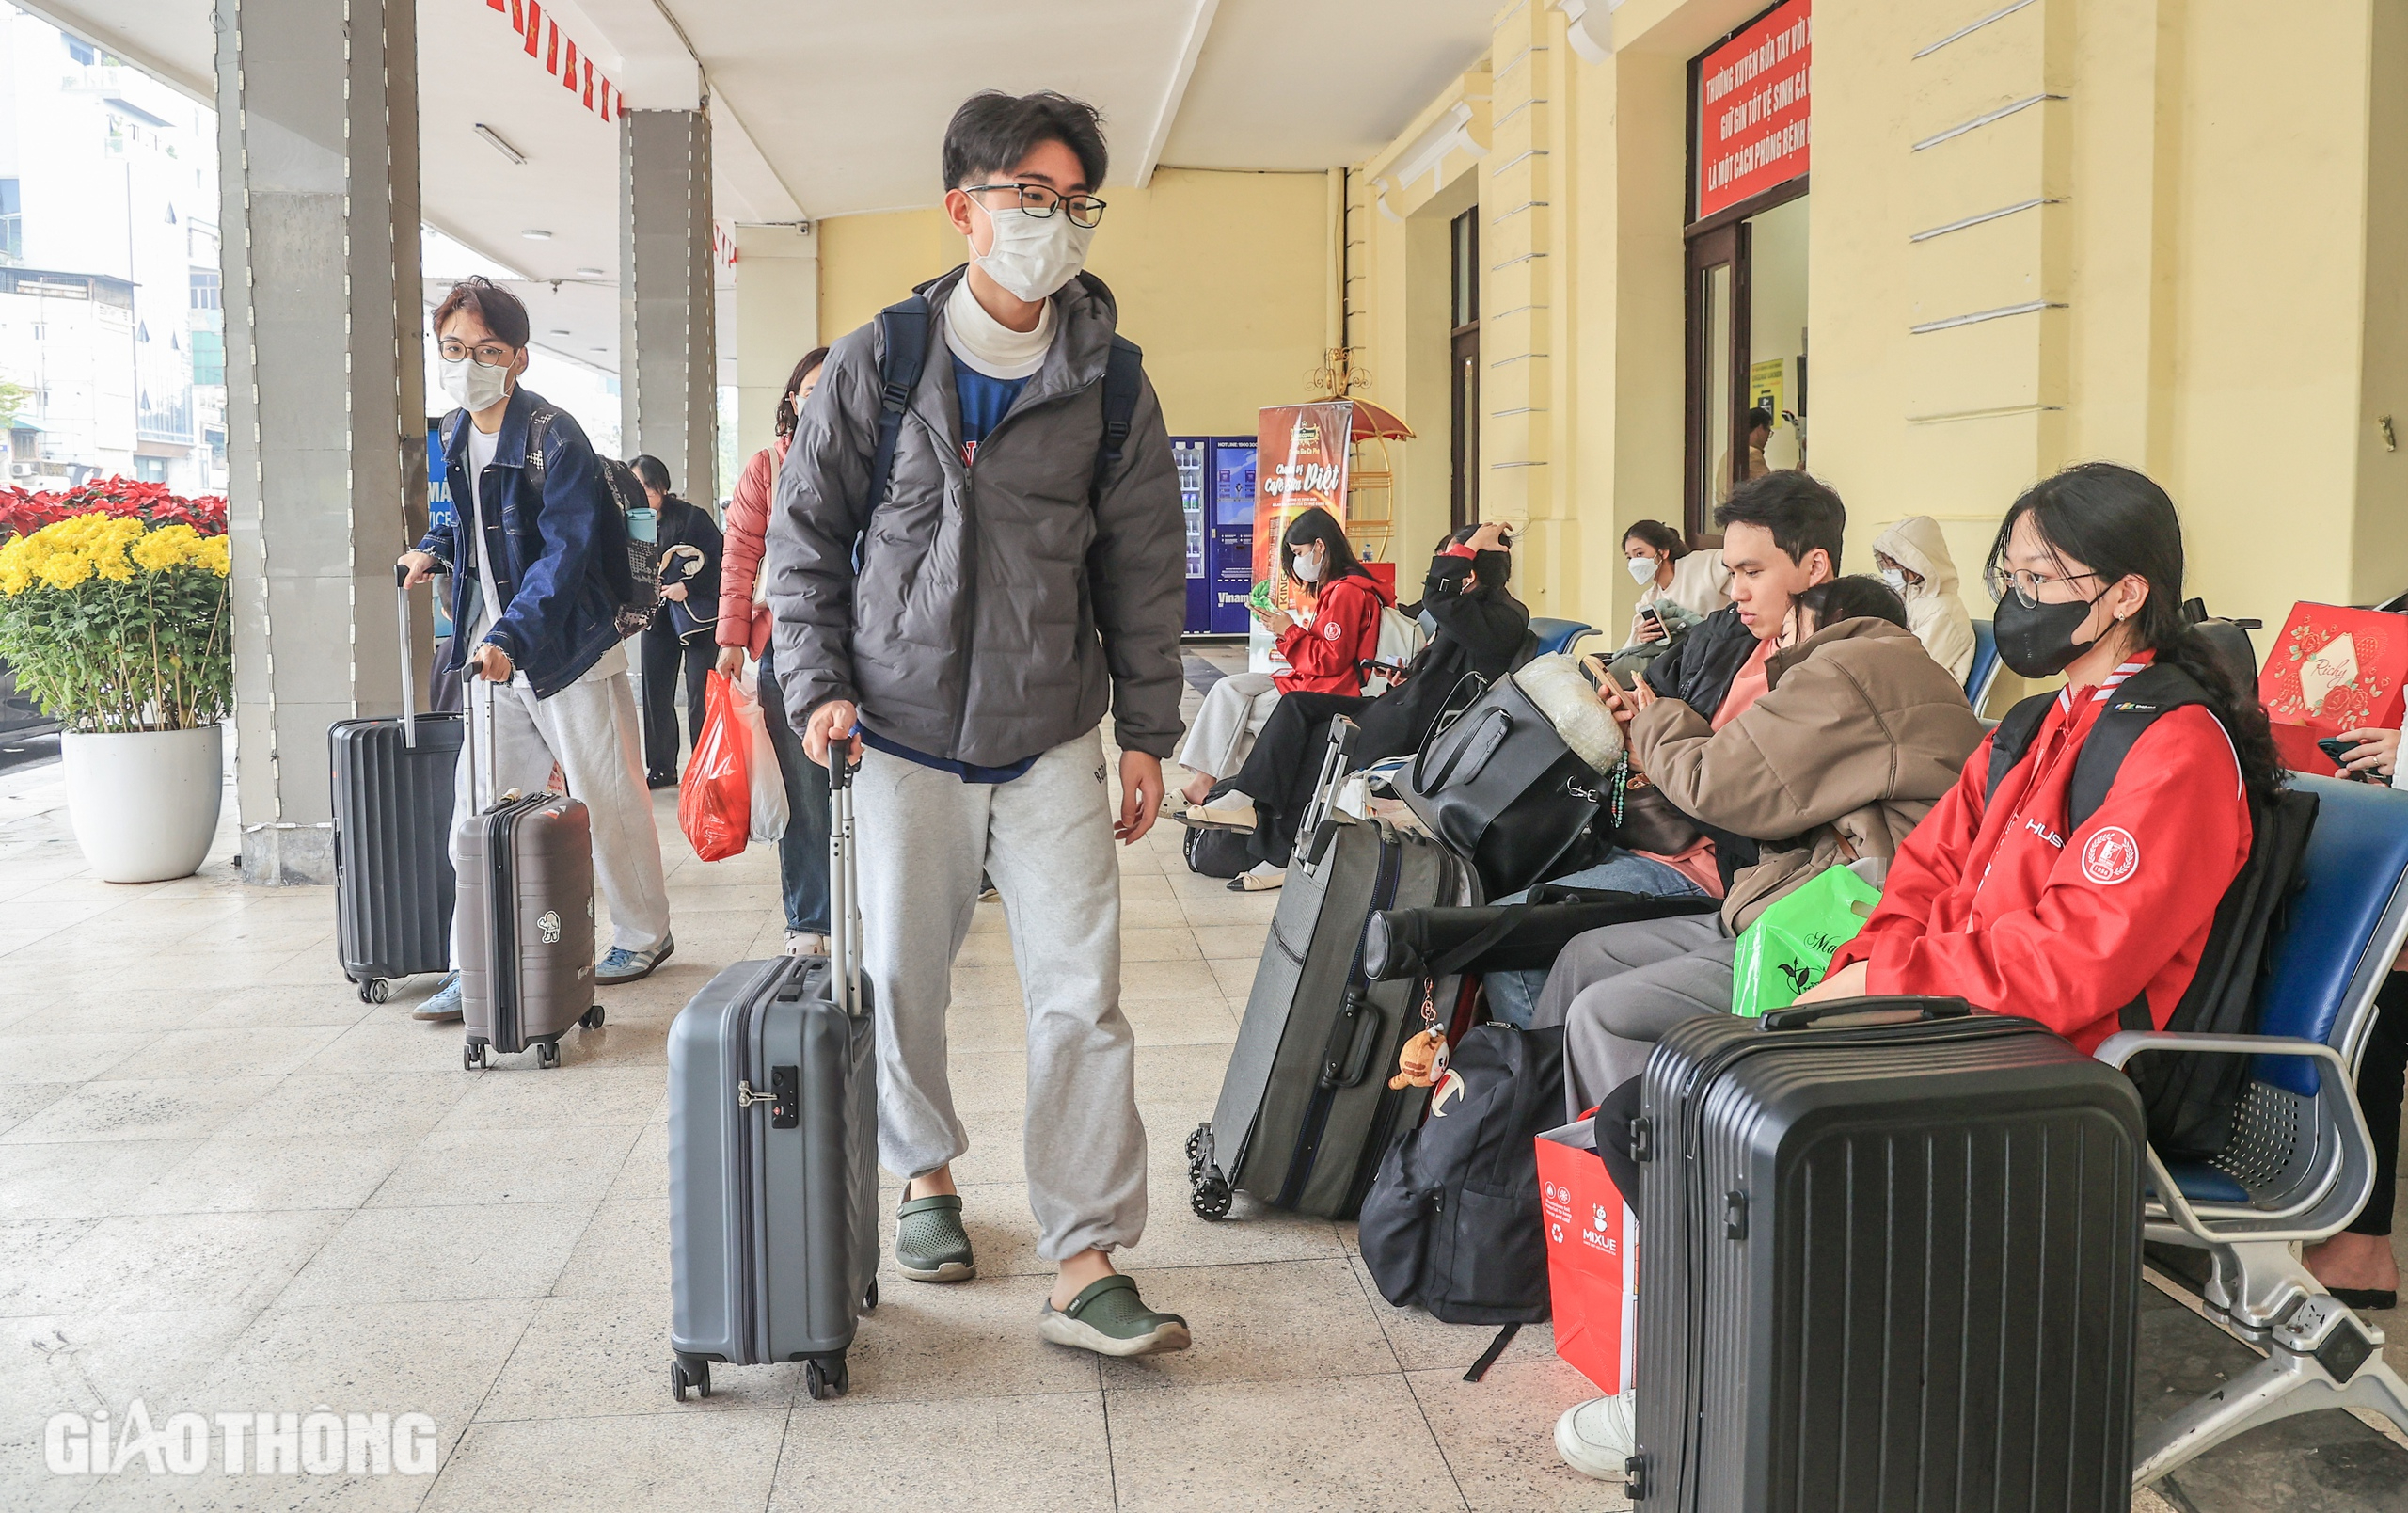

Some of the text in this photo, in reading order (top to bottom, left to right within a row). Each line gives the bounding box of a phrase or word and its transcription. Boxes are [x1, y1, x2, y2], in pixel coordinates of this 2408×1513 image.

[1706, 66, 1734, 105] THƯỜNG
[1734, 47, 1759, 89] XUYÊN
[1759, 33, 1776, 74] RỬA
[1776, 28, 1791, 63] TAY
[1791, 15, 1806, 54] VỚI
[1734, 100, 1748, 135] GÌN
[1748, 87, 1762, 126] TỐT
[1762, 82, 1773, 122] VỆ
[1773, 75, 1794, 112] SINH
[1795, 62, 1807, 101] CÁ
[1708, 158, 1718, 192] LÀ
[1718, 151, 1734, 190] MỘT
[1734, 144, 1754, 180] CÁCH
[1754, 130, 1782, 169] PHÒNG
[1782, 118, 1806, 159] BỆNH
[1304, 462, 1340, 497] Việt
[1279, 572, 1288, 605] KING
[2310, 659, 2350, 689] Richy
[2025, 818, 2066, 849] HUS
[1583, 1228, 1617, 1252] MIXUE
